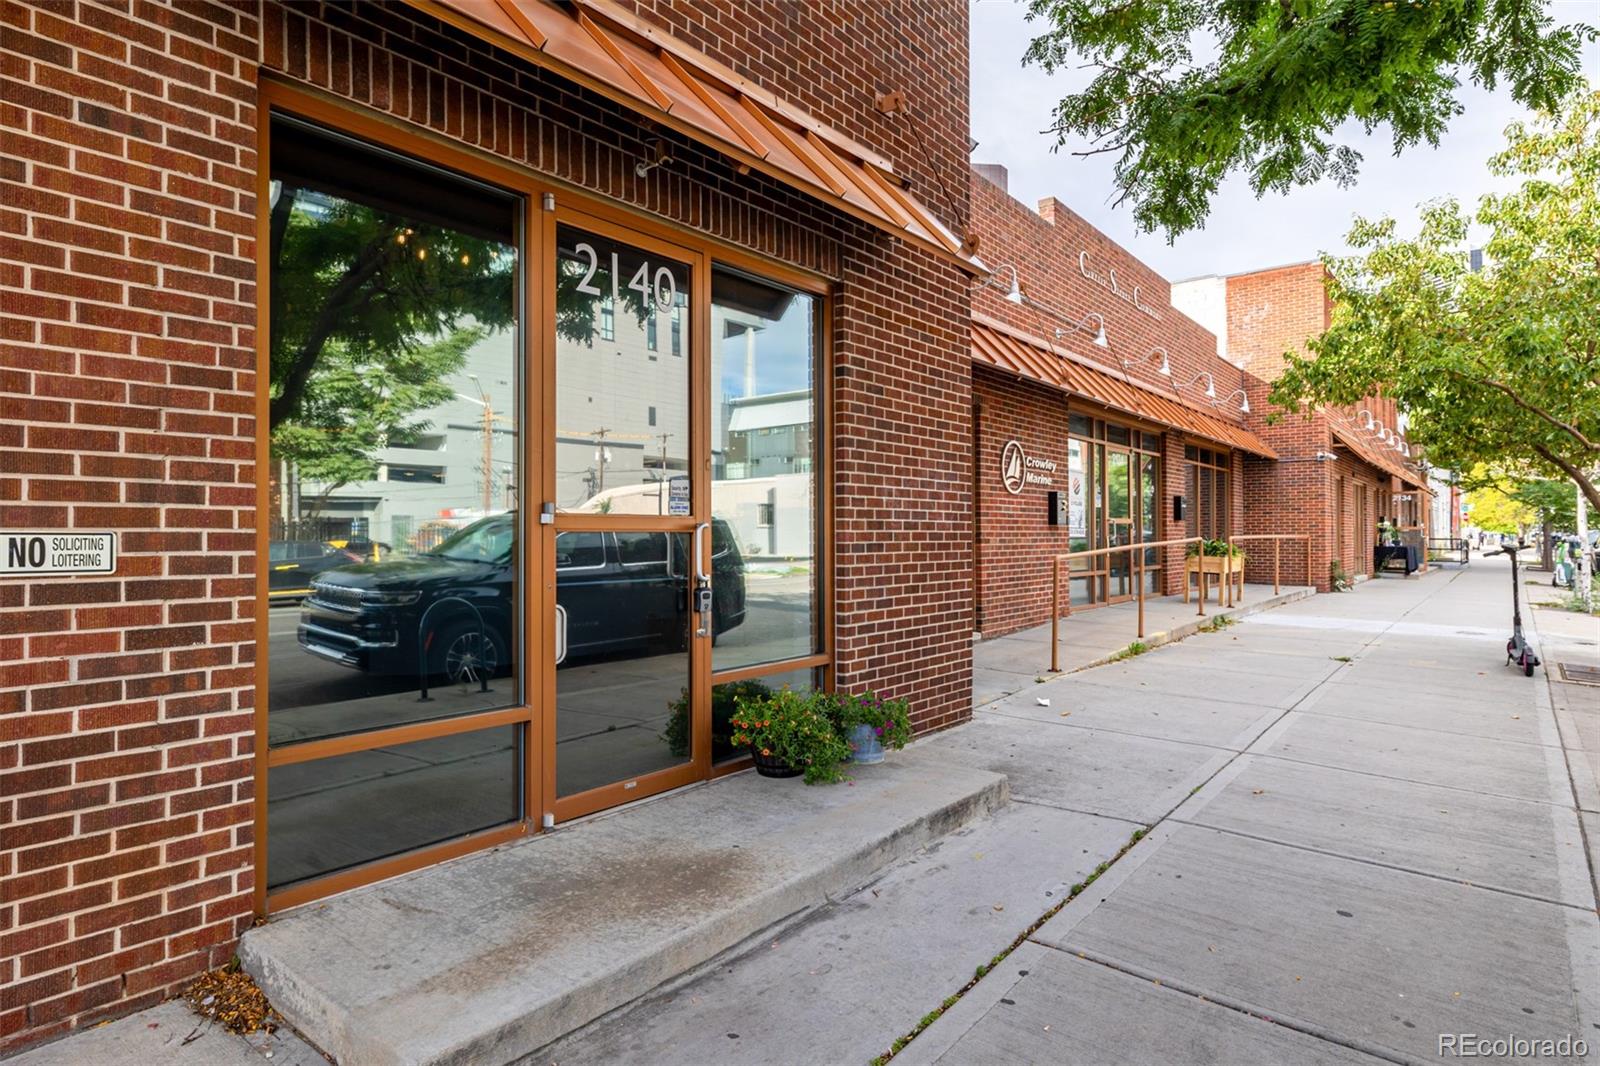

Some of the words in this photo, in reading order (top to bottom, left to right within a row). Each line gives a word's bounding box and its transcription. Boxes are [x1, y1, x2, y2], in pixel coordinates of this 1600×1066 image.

[575, 242, 676, 313] 2140
[1026, 456, 1057, 473] Crowley
[1026, 472, 1053, 485] Marine
[52, 537, 104, 551] SOLICITING
[8, 537, 46, 568] NO
[52, 553, 101, 567] LOITERING
